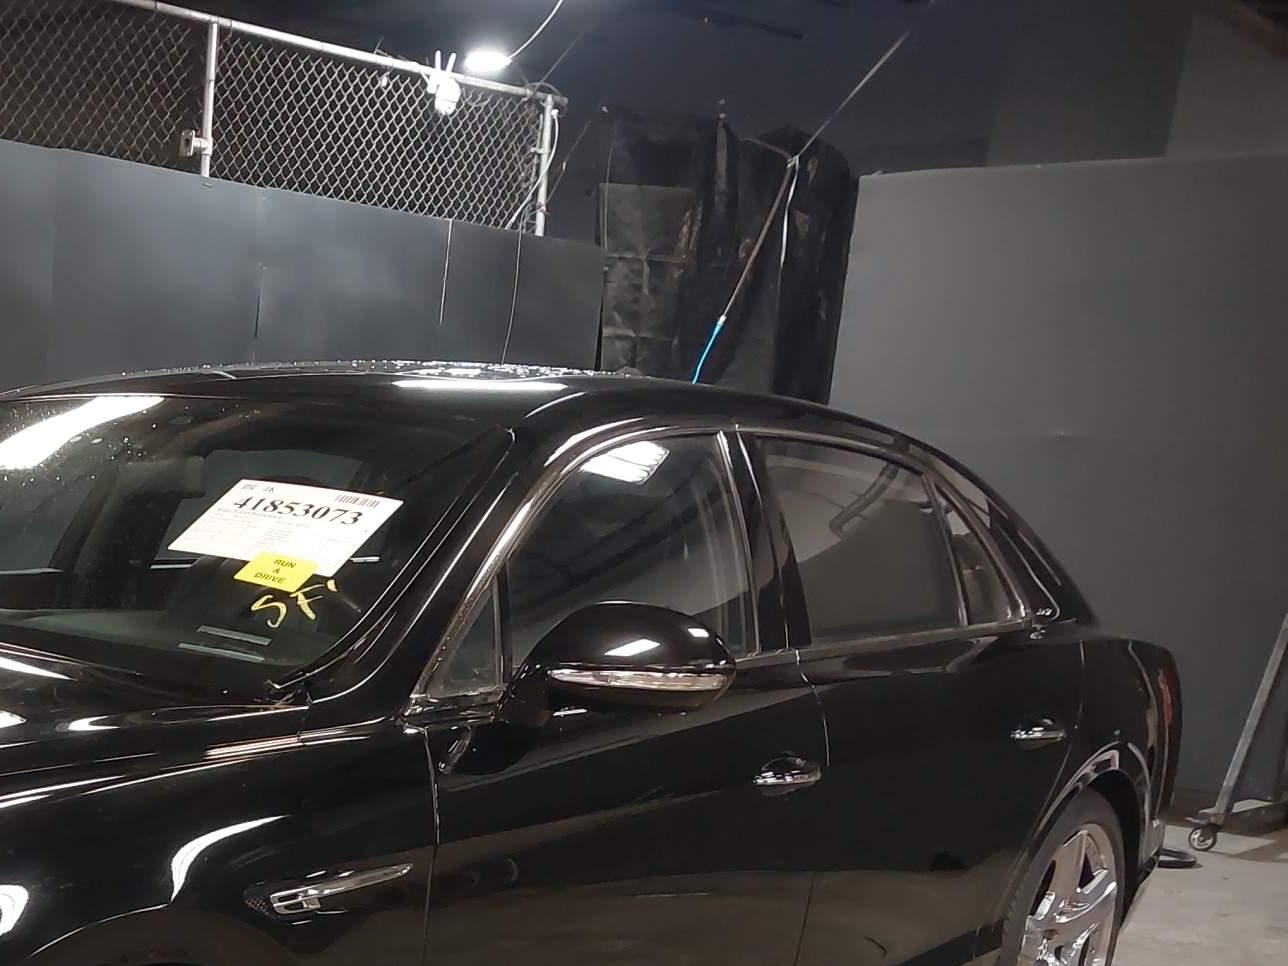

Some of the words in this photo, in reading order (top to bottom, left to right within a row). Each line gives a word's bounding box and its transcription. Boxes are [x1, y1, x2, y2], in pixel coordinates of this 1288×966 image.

[233, 496, 363, 525] 41853073
[273, 559, 296, 569] RUN
[254, 572, 286, 584] DRIVE
